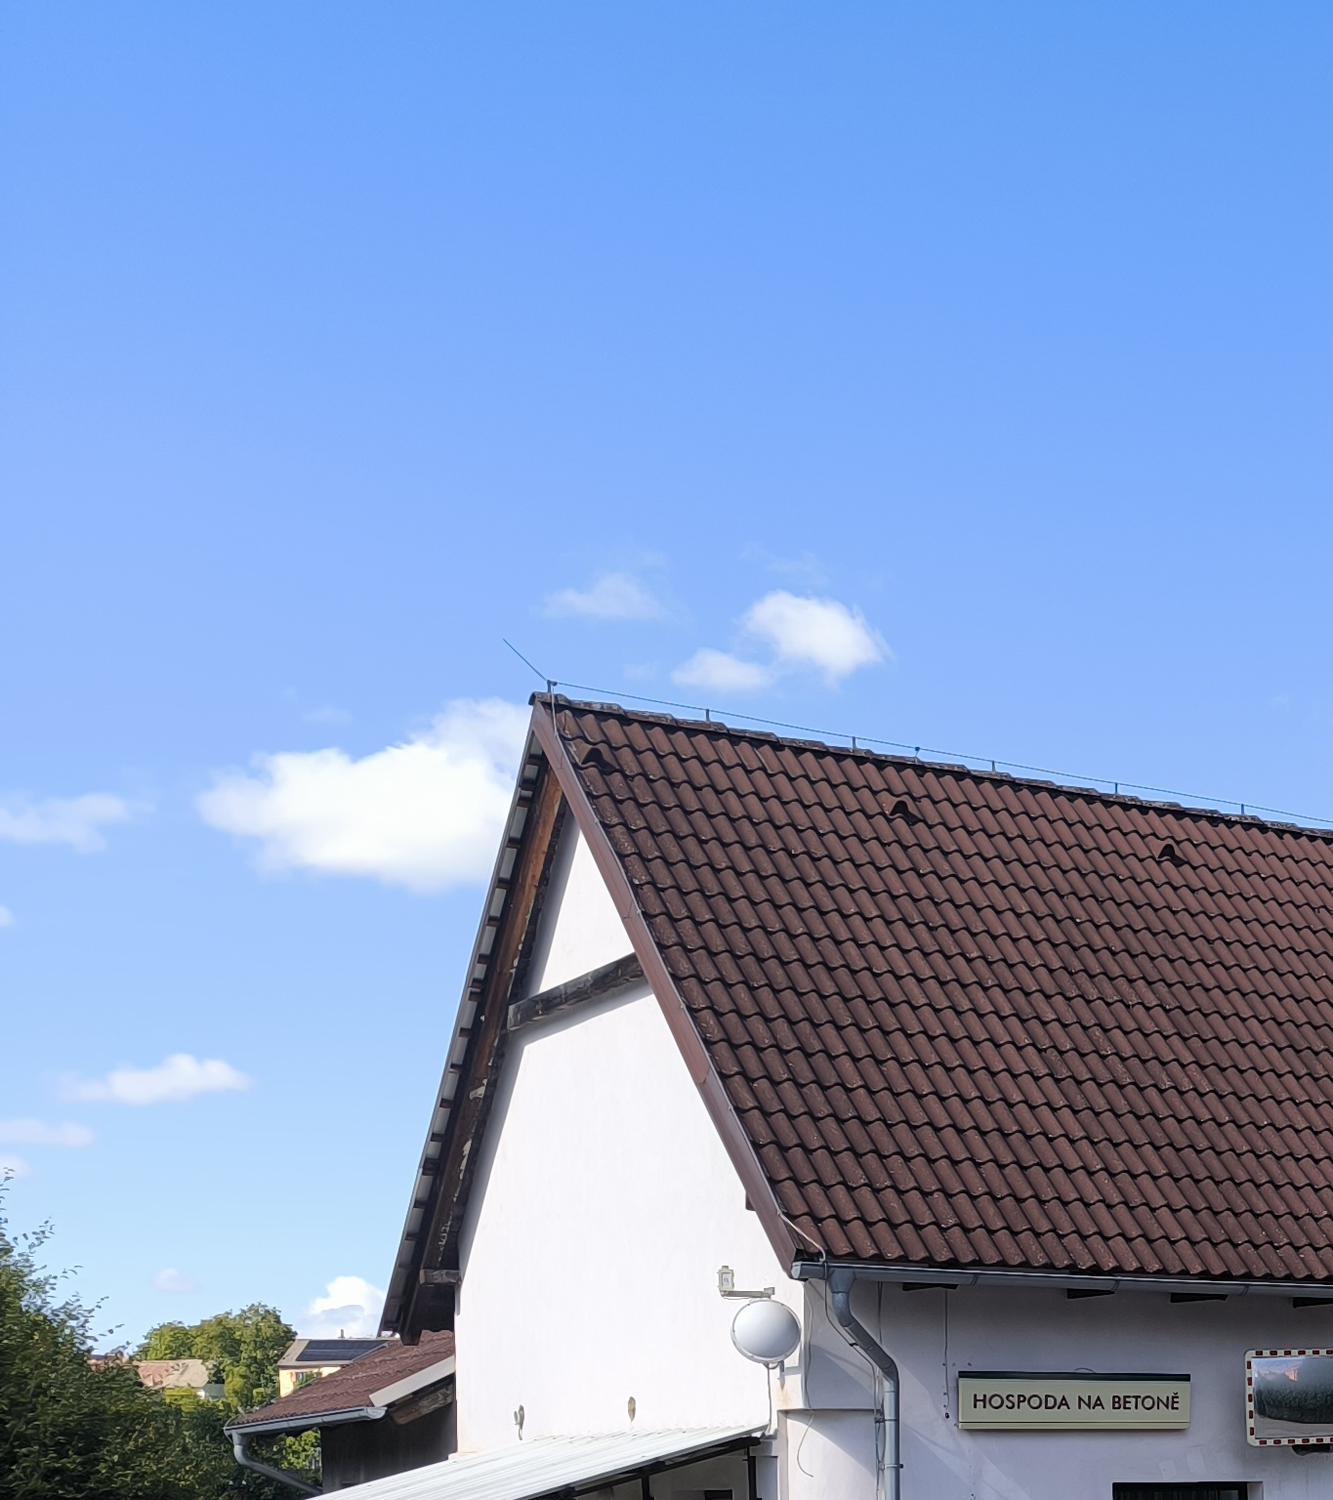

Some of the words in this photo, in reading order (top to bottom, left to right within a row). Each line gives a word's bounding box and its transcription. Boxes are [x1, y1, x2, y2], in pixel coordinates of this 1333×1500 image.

[973, 1393, 1070, 1410] HOSPODA
[1077, 1395, 1105, 1410] NA
[1112, 1392, 1180, 1411] BETONĚ
